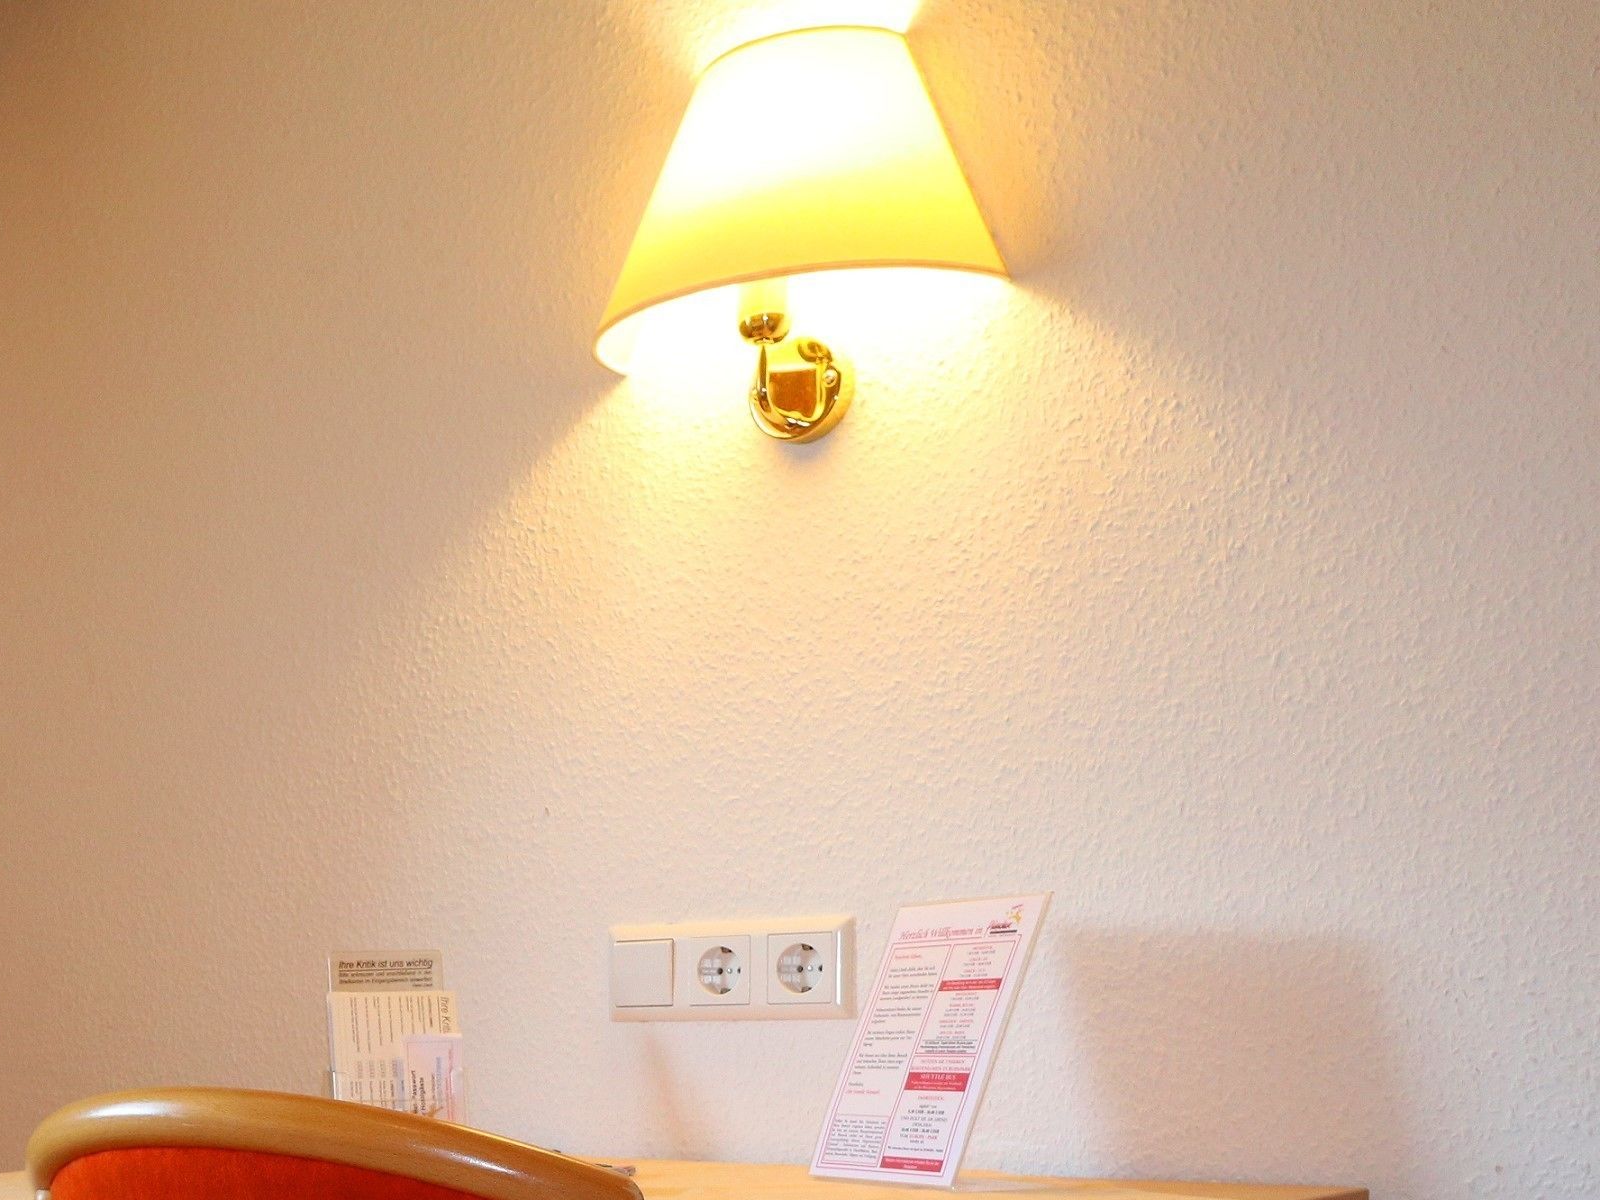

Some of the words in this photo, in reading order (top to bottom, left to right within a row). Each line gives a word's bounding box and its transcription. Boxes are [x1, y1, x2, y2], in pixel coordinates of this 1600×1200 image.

[338, 960, 354, 969] Ihre
[356, 959, 376, 968] Kritik
[378, 959, 387, 968] ist
[389, 960, 404, 968] uns
[406, 958, 433, 969] wichtig
